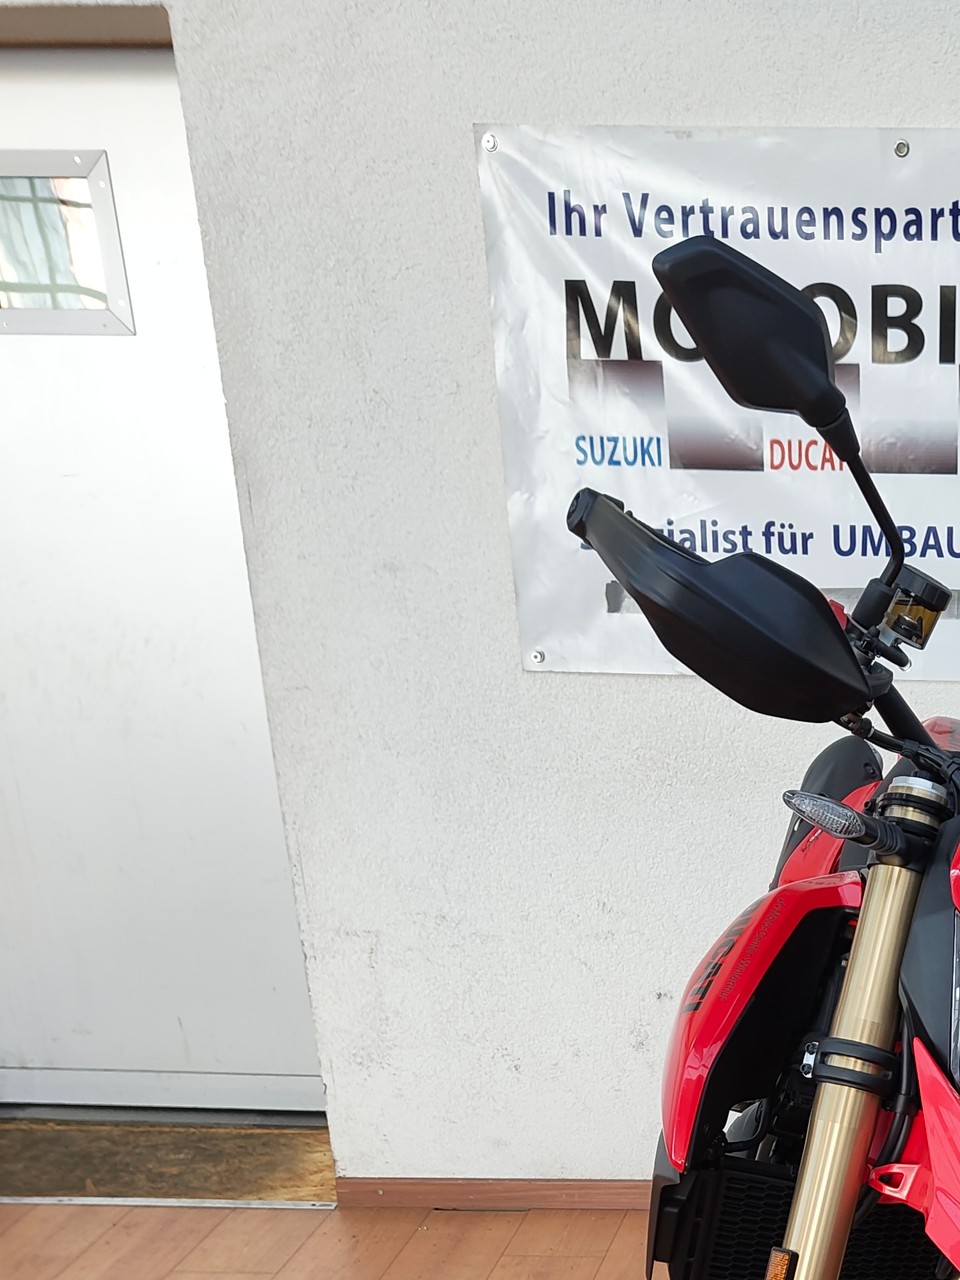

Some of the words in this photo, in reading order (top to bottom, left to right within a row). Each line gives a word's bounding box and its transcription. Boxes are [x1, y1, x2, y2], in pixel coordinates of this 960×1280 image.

[547, 189, 607, 238] Ihr
[575, 435, 662, 467] SUZUKI
[761, 520, 814, 556] für
